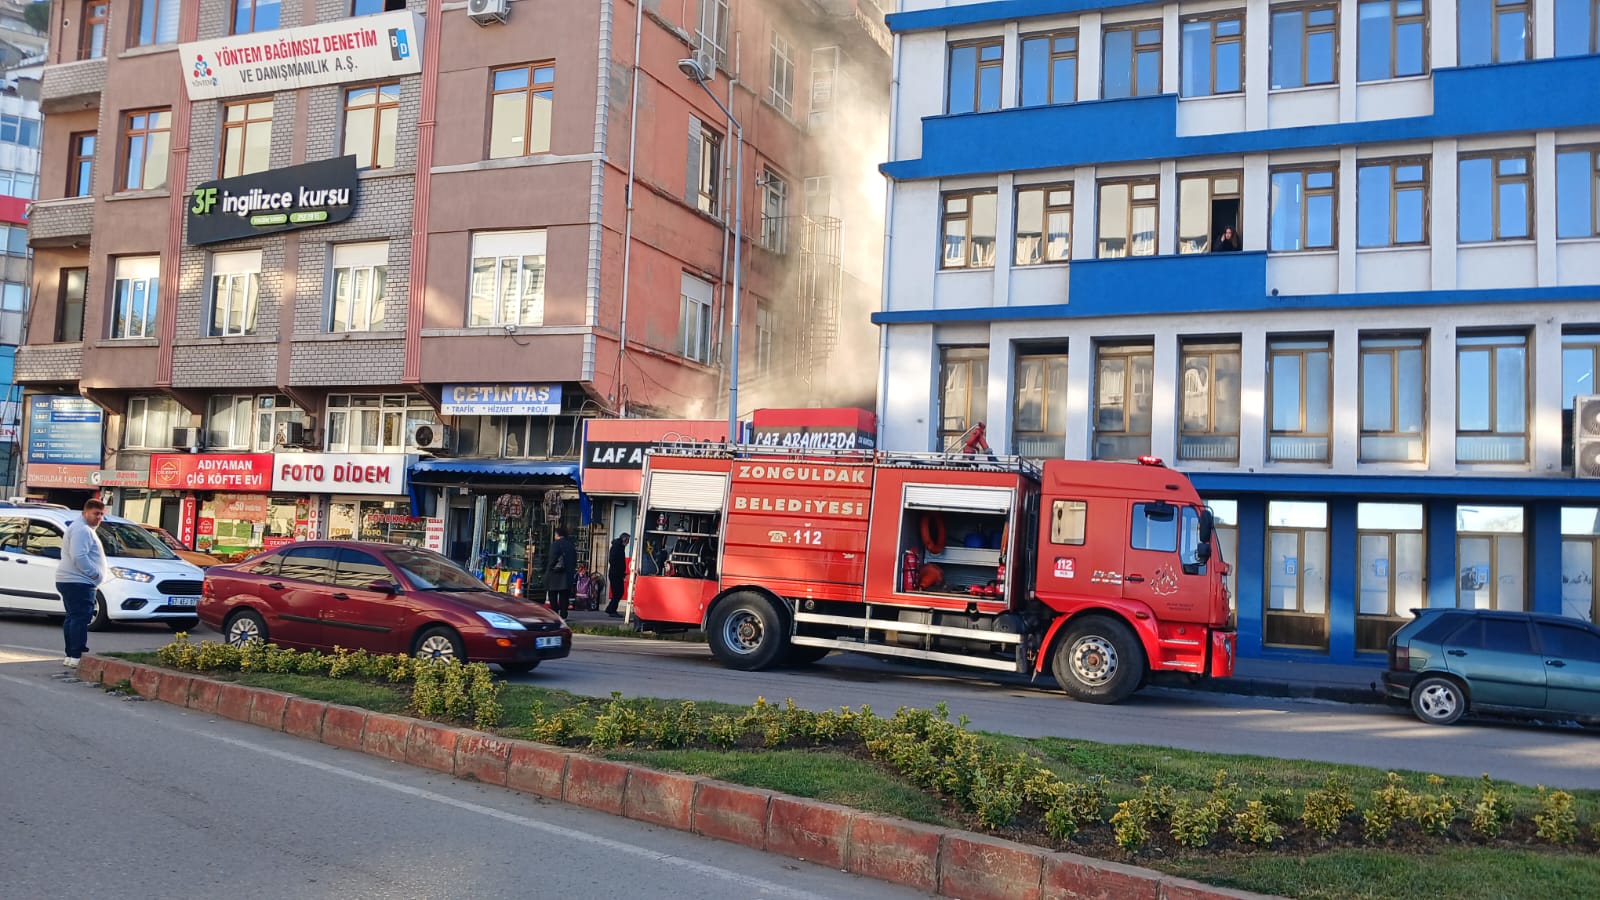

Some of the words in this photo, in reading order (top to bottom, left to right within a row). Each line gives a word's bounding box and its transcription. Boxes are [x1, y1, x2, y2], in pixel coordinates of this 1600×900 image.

[214, 45, 263, 67] YÖNTEM
[264, 37, 321, 60] BAĞIMSIZ
[323, 27, 378, 53] DENETİM
[239, 67, 253, 83] VE
[256, 58, 329, 82] DANIŞMANLIK
[335, 55, 358, 73] A.Ş.
[191, 187, 217, 214] 3F
[223, 188, 293, 217] ingilizce
[299, 185, 350, 207] kursu
[453, 384, 550, 405] ÇETİNTAŞ
[452, 405, 475, 413] TRAFİK
[487, 404, 514, 413] HİZMET
[527, 405, 549, 413] PROJE
[755, 431, 780, 447] LAF
[592, 448, 627, 463] LAF
[197, 459, 253, 470] ADIYAMAN
[281, 463, 324, 481] FOTO
[333, 461, 391, 484] DİDEM
[186, 471, 204, 486] ÇİĞ
[207, 473, 242, 485] KÖFTE
[245, 472, 263, 485] EVİ
[738, 465, 865, 483] ZONGULDAK
[1056, 558, 1073, 571] 112
